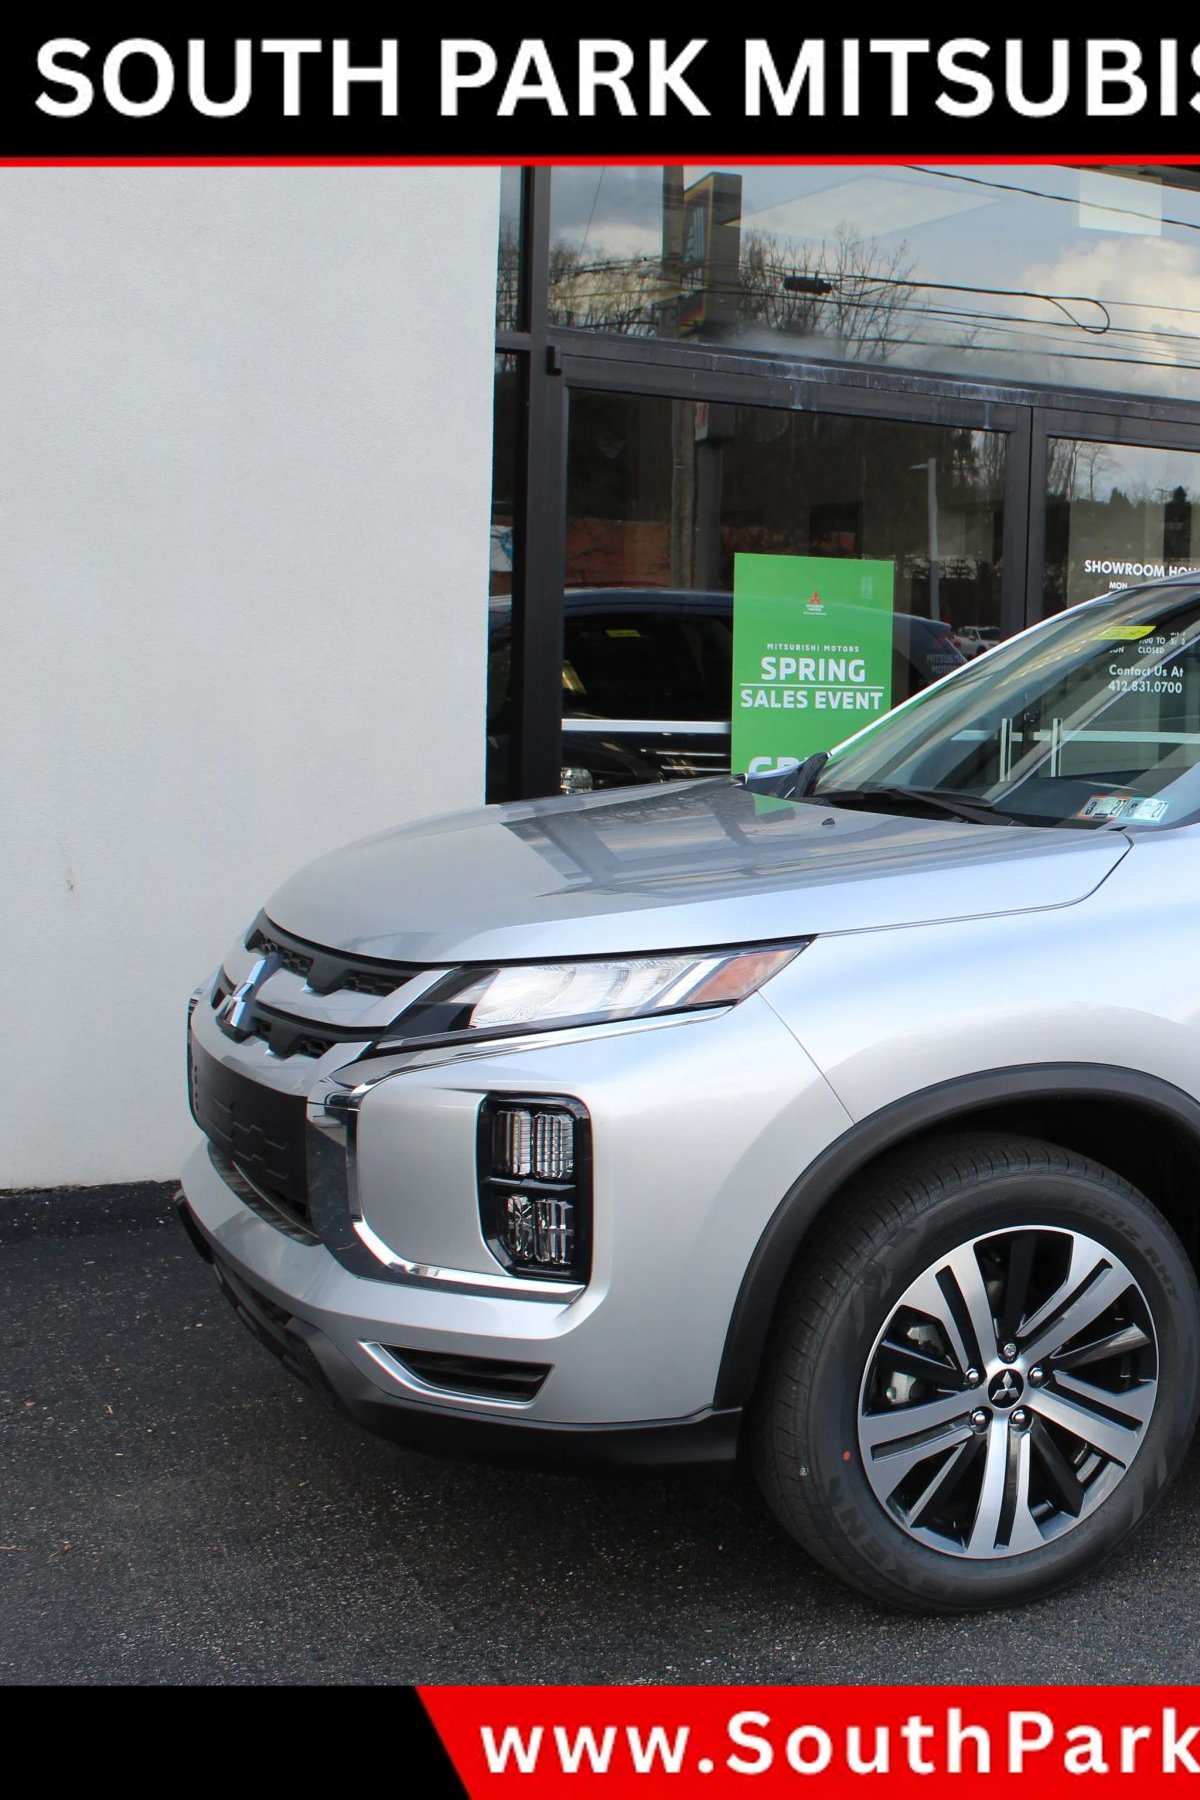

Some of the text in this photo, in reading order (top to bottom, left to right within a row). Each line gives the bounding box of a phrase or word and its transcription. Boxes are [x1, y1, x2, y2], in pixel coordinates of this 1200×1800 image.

[1084, 559, 1199, 577] SHOWROOM HO
[1109, 581, 1128, 589] MON
[767, 643, 860, 653] MITSUBISHI MOTORS
[1138, 646, 1165, 654] CLOSED
[761, 656, 866, 683] SPRING
[1109, 664, 1184, 677] Contact Us At
[1108, 680, 1183, 694] 412.831.0700
[740, 689, 883, 710] SALES EVENT
